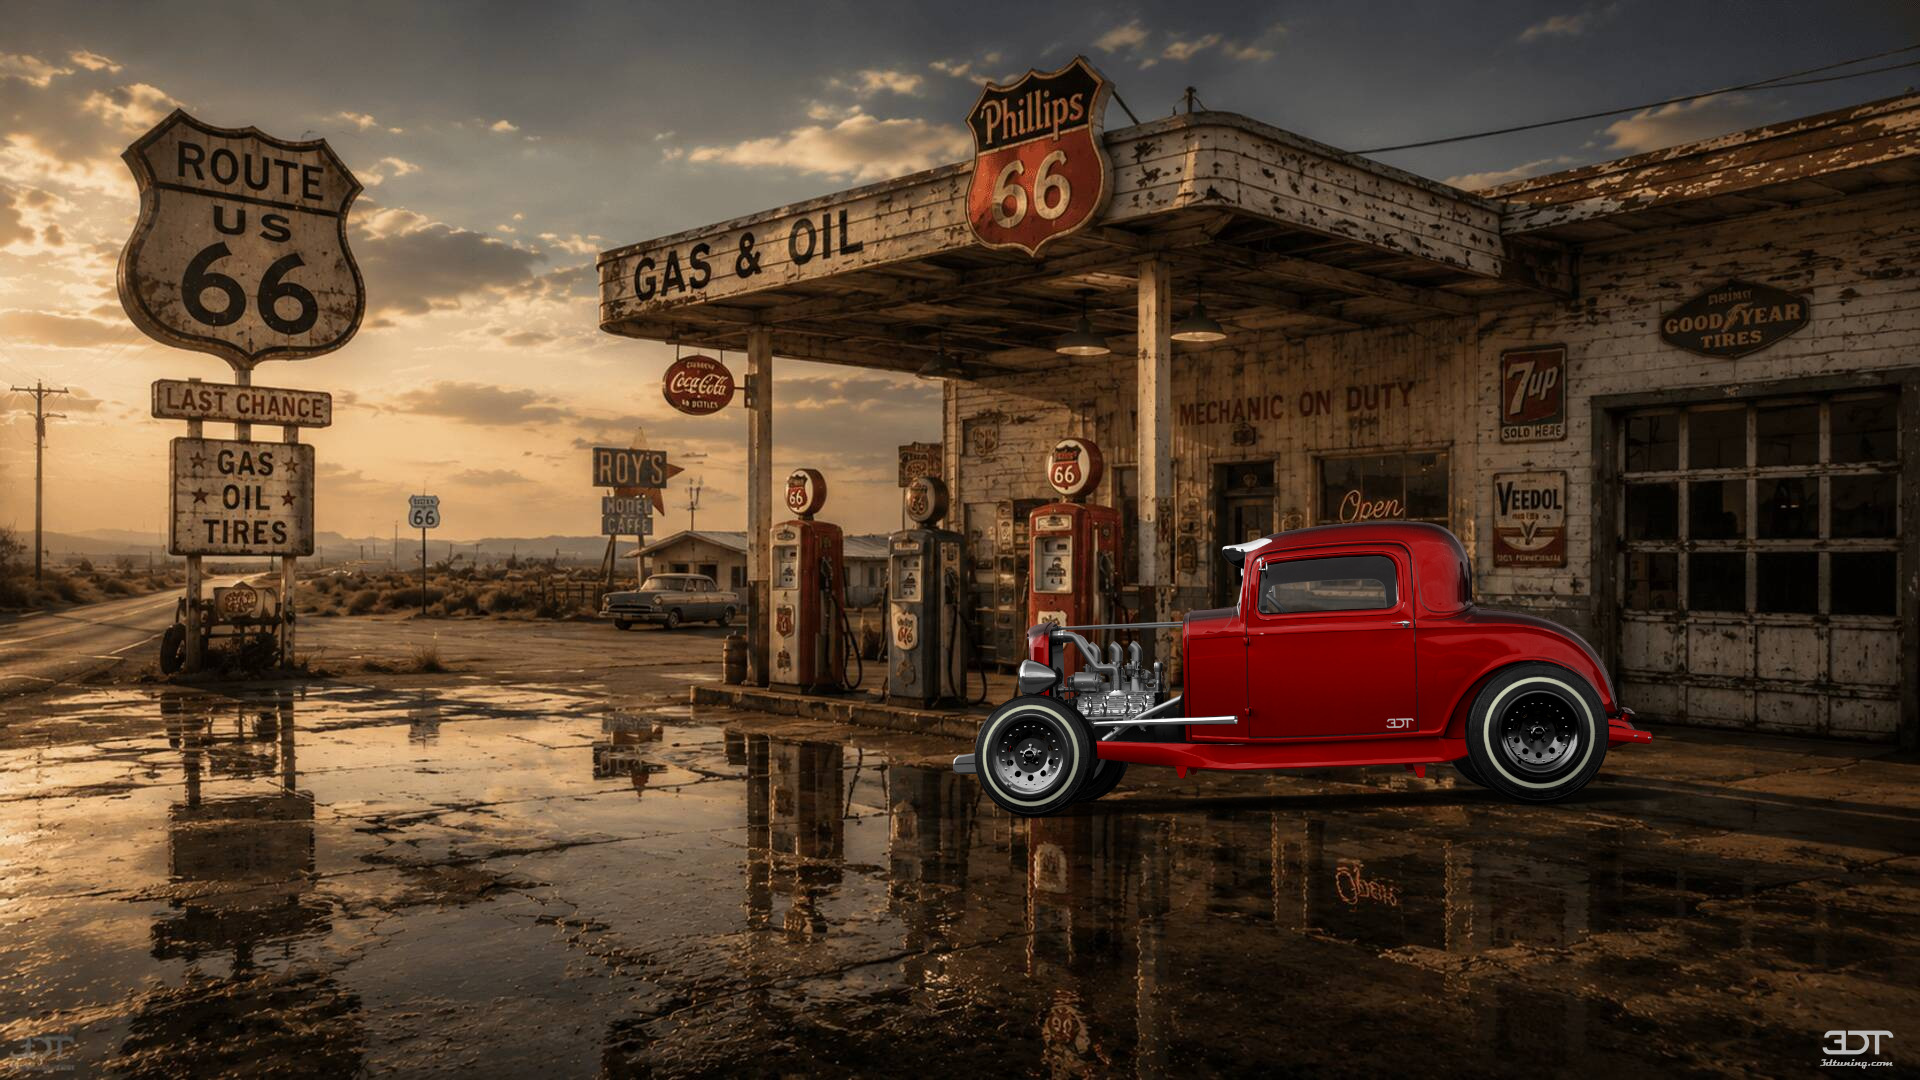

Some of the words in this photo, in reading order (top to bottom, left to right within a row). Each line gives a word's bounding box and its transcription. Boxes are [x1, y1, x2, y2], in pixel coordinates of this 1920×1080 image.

[980, 90, 1083, 145] Phillips
[177, 141, 324, 201] ROUTE
[991, 150, 1071, 229] 66
[213, 205, 291, 243] US
[634, 242, 712, 302] GAS
[735, 232, 762, 278] &
[788, 208, 864, 266] OIL
[181, 241, 319, 336] 66
[1701, 330, 1763, 349] TIRES
[165, 387, 228, 411] LAST
[235, 392, 324, 418] CHANCE
[1179, 394, 1284, 426] MECHANIC
[1300, 389, 1331, 417] ON
[1346, 381, 1415, 413] DUTY
[1503, 427, 1530, 439] SOLD
[1536, 424, 1562, 437] HERE
[217, 450, 275, 477] GAS
[600, 451, 663, 484] ROY'S
[1054, 464, 1075, 484] 66
[221, 484, 271, 511] OIL
[789, 489, 803, 505] 66
[1339, 489, 1404, 523] Open
[1496, 481, 1563, 516] VEEDOL
[203, 519, 288, 546] TIRES
[413, 509, 436, 526] 66
